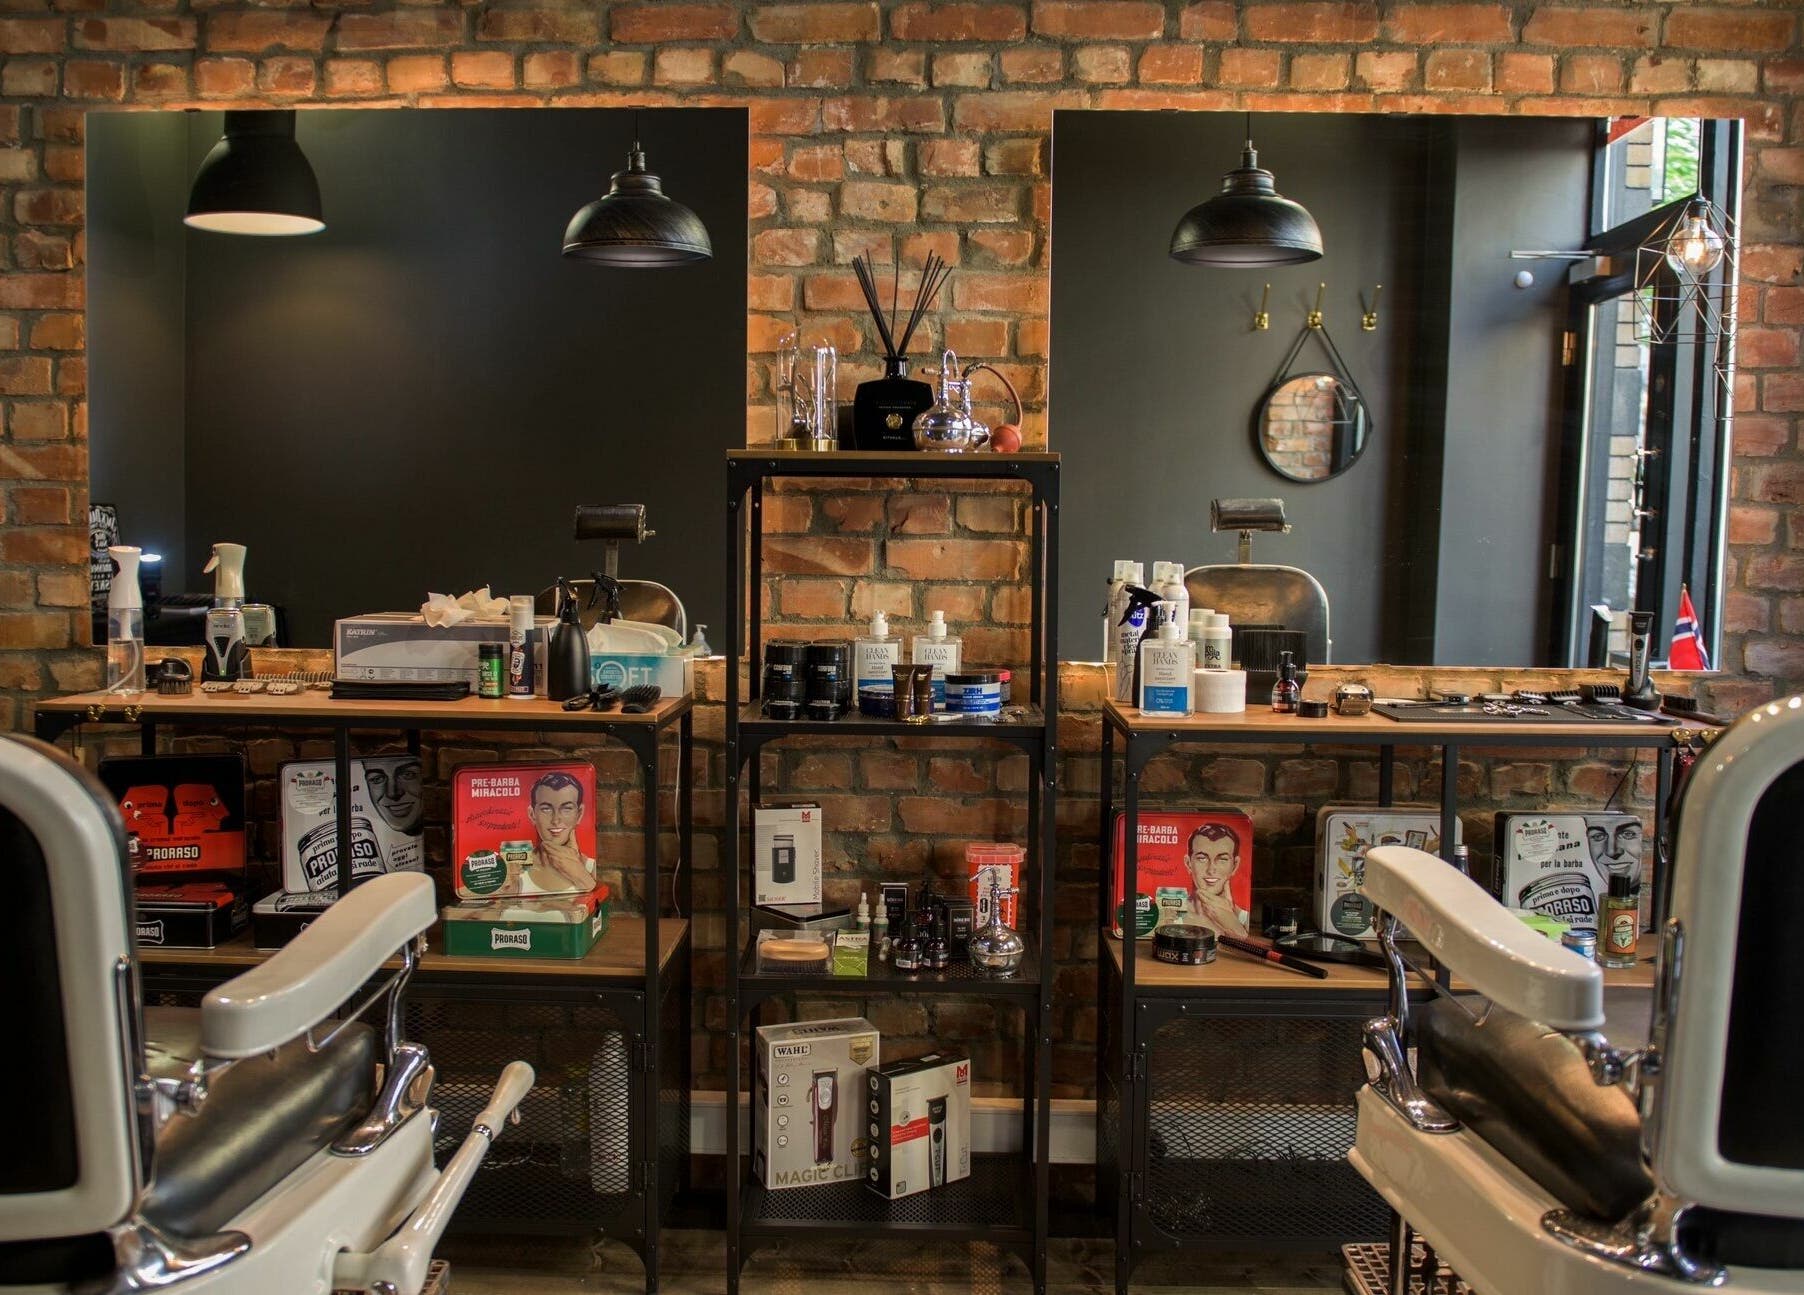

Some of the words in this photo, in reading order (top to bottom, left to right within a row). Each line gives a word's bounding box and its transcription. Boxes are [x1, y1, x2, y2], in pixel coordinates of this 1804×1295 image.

[345, 628, 376, 636] KATRIN
[471, 777, 520, 788] PRE-BARBA
[471, 787, 521, 798] MIRACOLO
[1137, 825, 1178, 835] RE-BARBA
[309, 841, 374, 878] PROSO
[1541, 898, 1590, 916] ORASO
[136, 927, 160, 938] ORASO
[494, 933, 528, 945] PRORASO
[777, 1045, 808, 1056] WAHL
[775, 1167, 828, 1186] MAGIC
